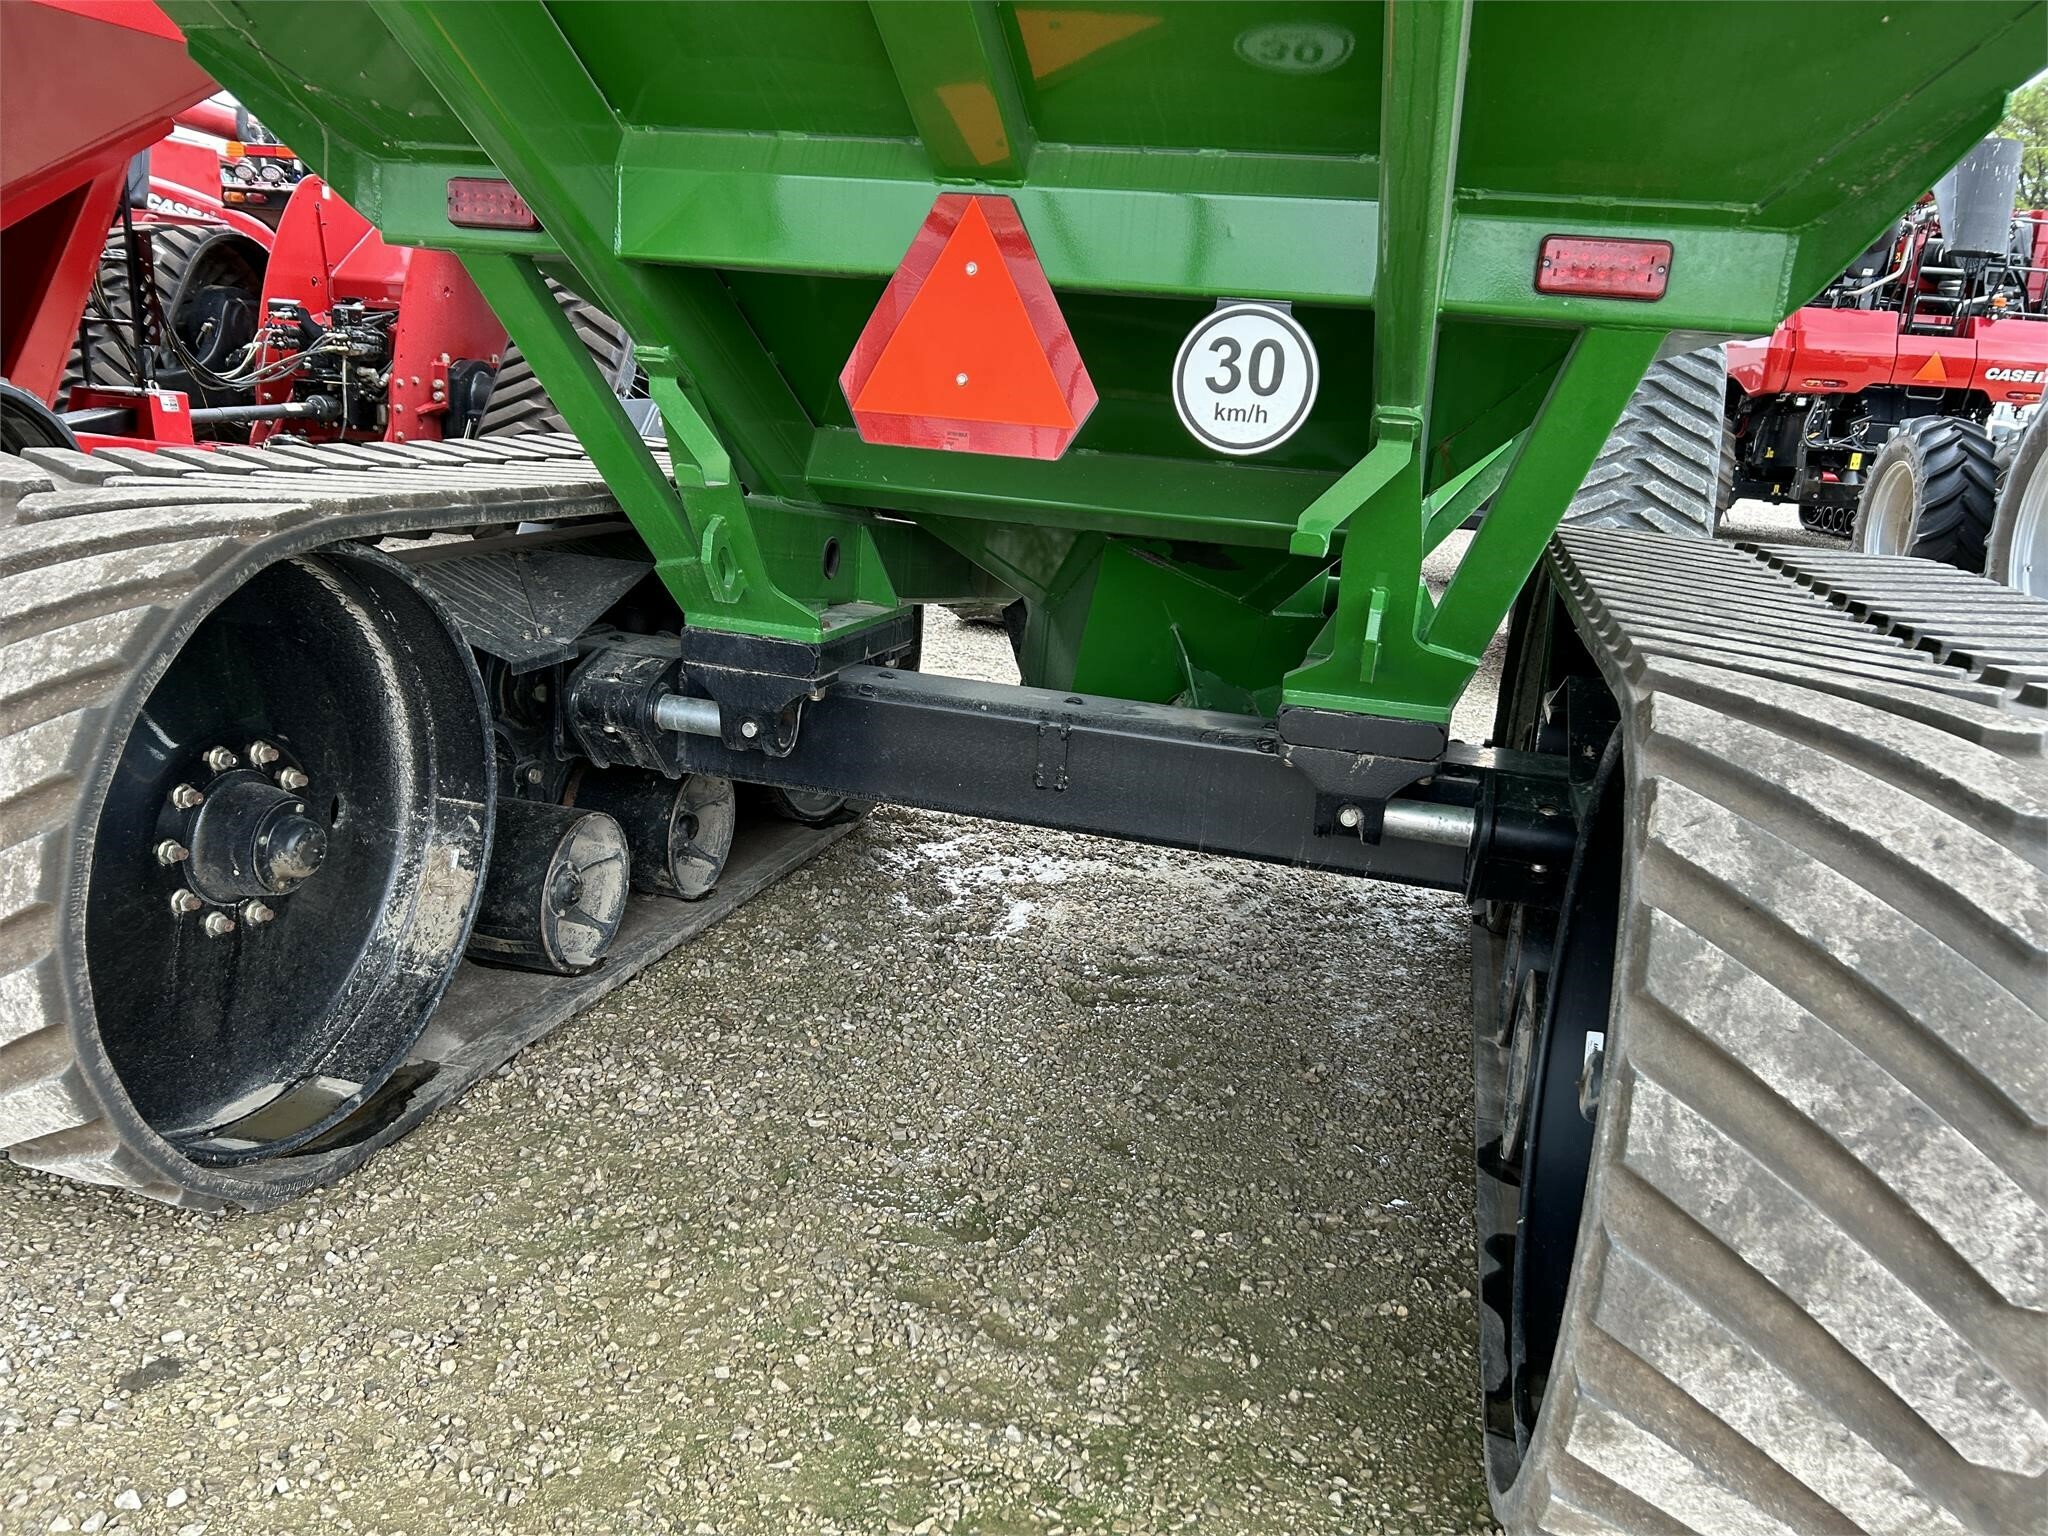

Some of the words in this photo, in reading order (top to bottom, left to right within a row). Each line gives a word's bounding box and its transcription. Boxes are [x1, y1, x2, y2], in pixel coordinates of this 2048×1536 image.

[1205, 336, 1285, 397] 30
[1984, 367, 2037, 383] CASE
[1213, 402, 1268, 424] km/h
